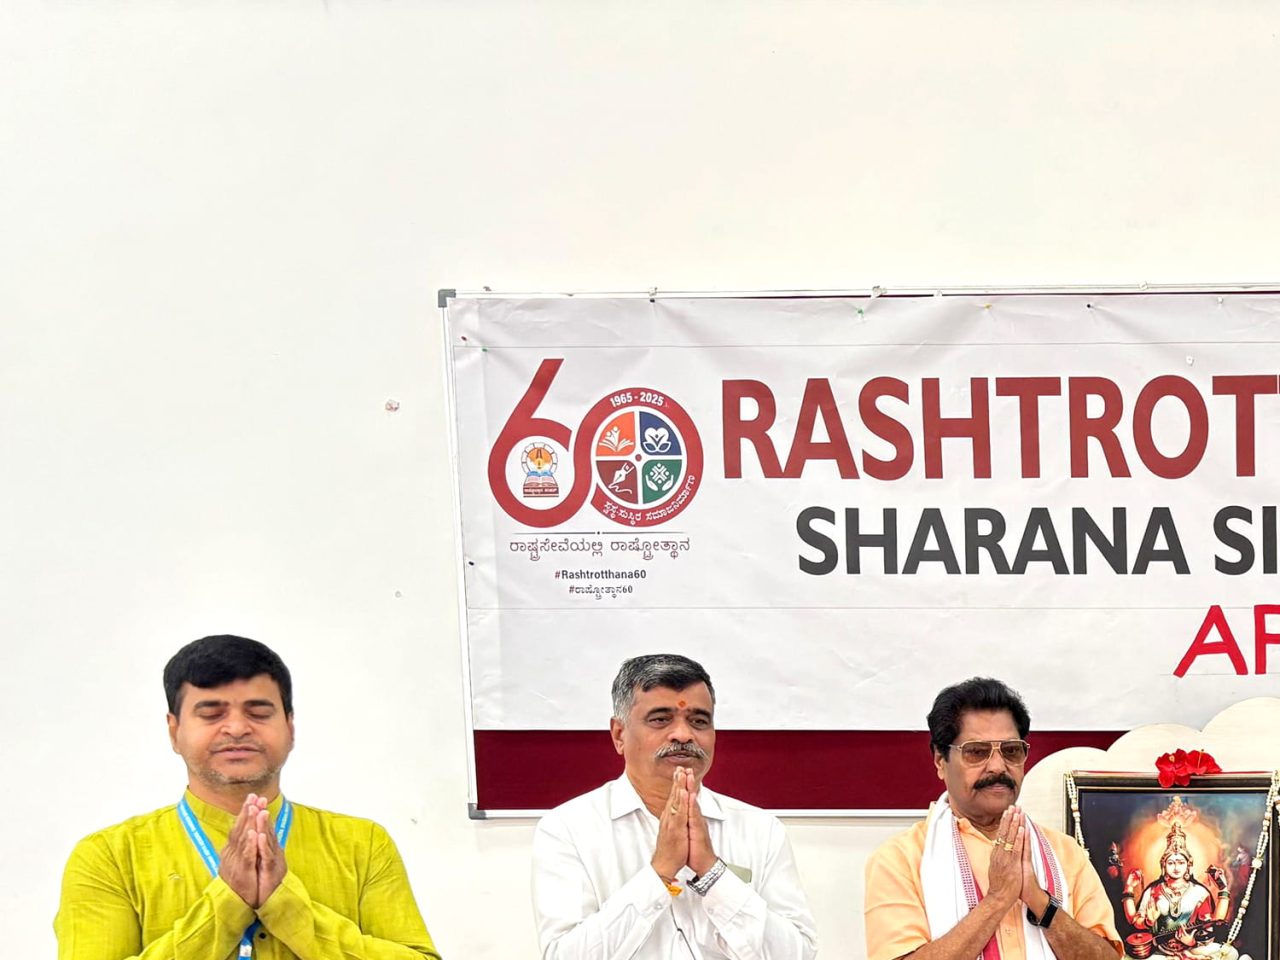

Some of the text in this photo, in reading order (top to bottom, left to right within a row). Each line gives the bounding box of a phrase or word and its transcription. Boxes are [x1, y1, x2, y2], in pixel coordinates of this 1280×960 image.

[610, 392, 633, 408] 1965
[639, 391, 665, 407] 2025
[796, 505, 1190, 577] SHARANA
[554, 569, 647, 580] #Rashtrotthana60
